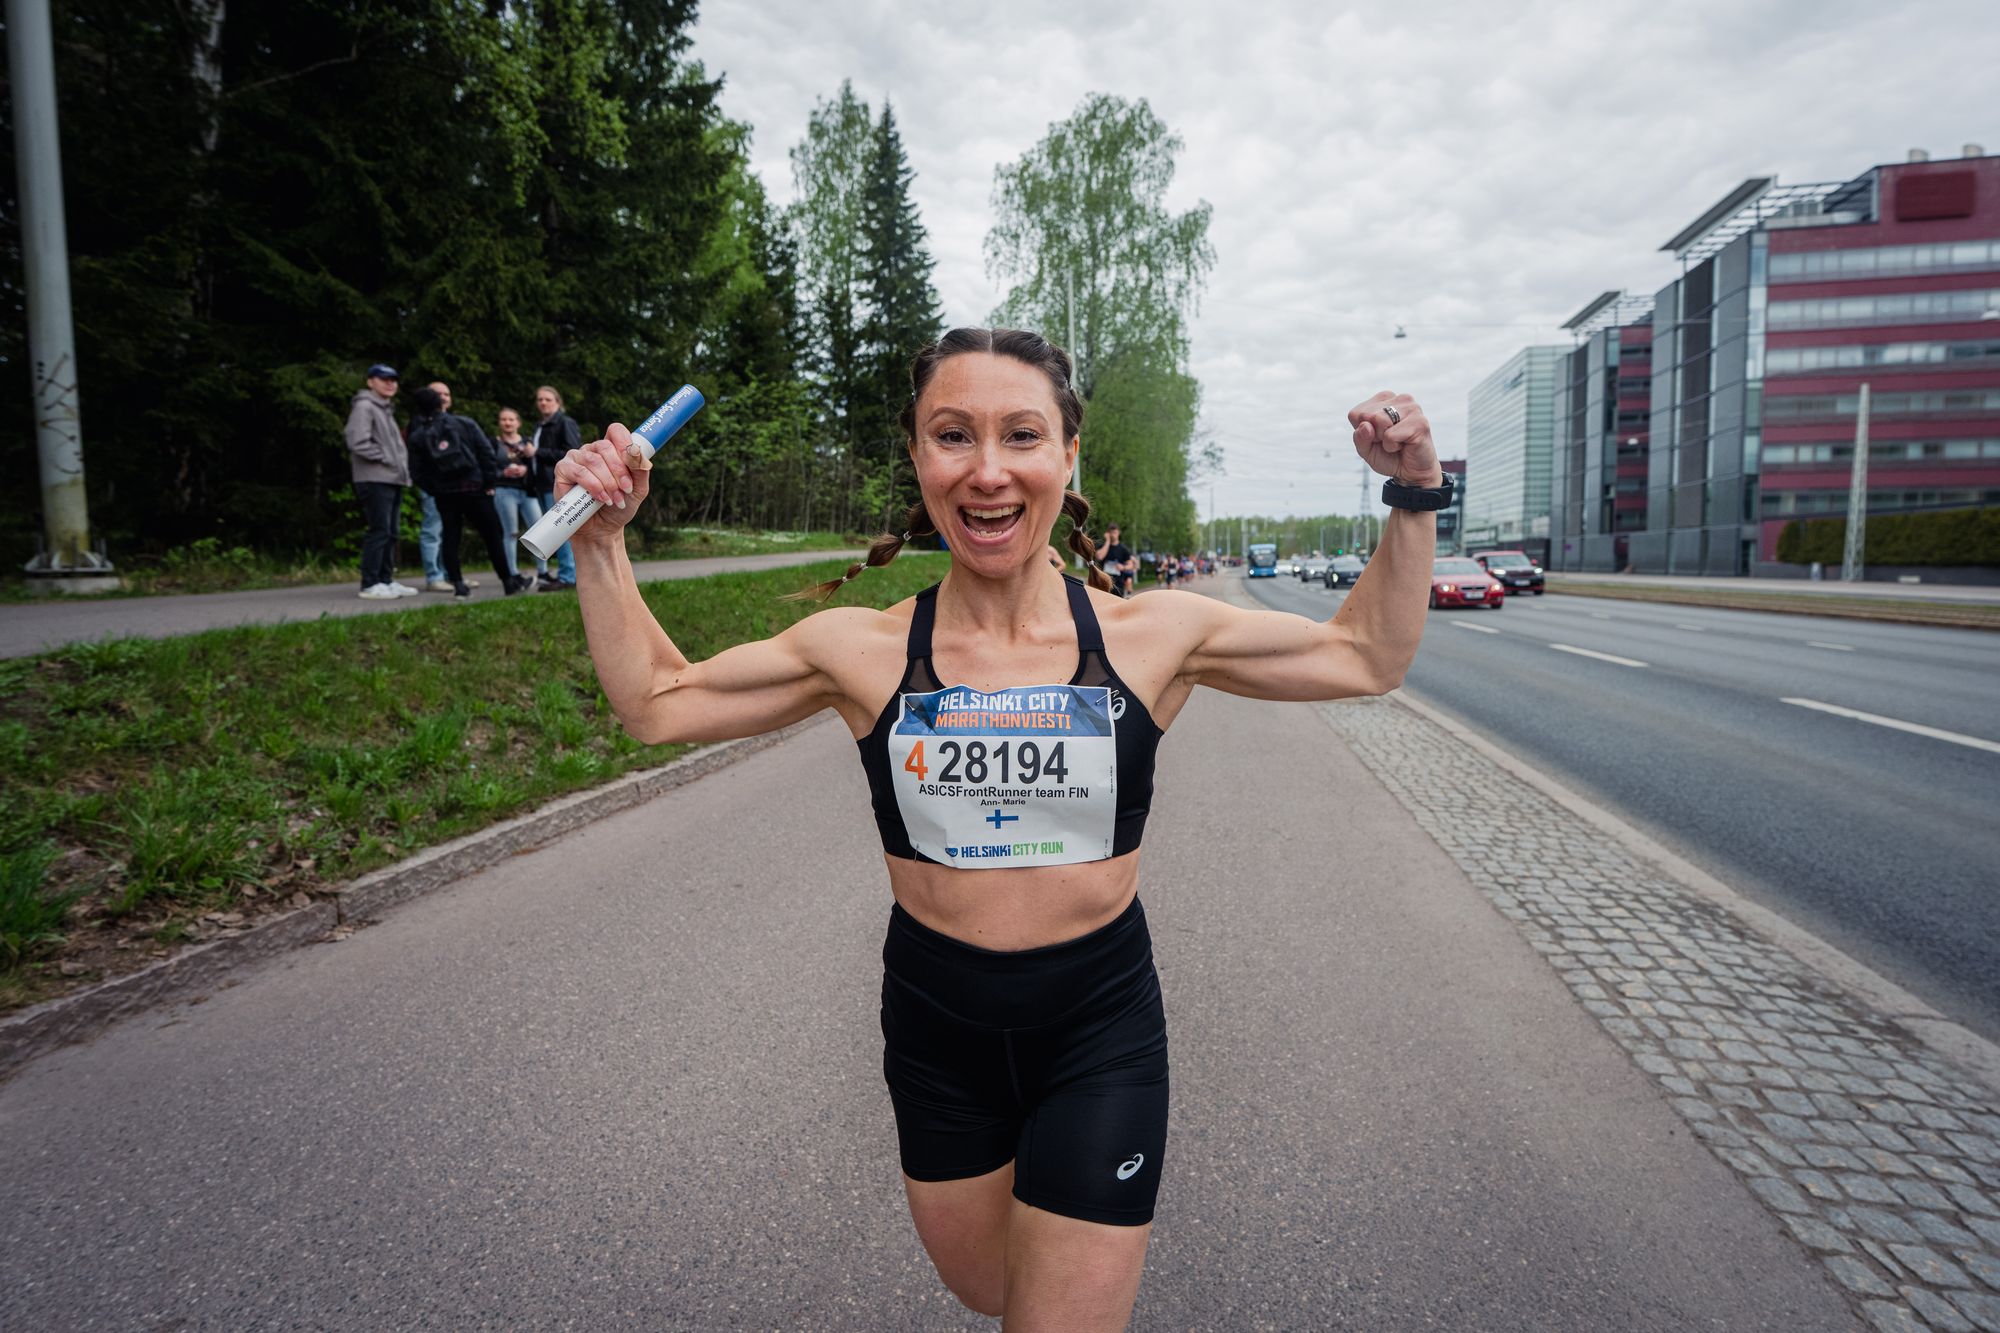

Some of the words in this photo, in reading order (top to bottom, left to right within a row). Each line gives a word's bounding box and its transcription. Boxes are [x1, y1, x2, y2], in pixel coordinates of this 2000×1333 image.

[656, 404, 673, 419] Sport
[640, 415, 661, 432] Service
[563, 505, 575, 516] back
[938, 692, 1022, 711] HELSINKI
[935, 712, 1071, 730] MARATHONVIESTI
[904, 740, 928, 781] 4
[938, 741, 1068, 784] 28194
[918, 783, 1032, 798] ASICSFrontRunner
[1035, 786, 1065, 798] team
[1069, 787, 1089, 799] FIN
[980, 798, 1001, 806] Ann-
[1002, 798, 1026, 806] Marie
[1041, 841, 1064, 855] RUN
